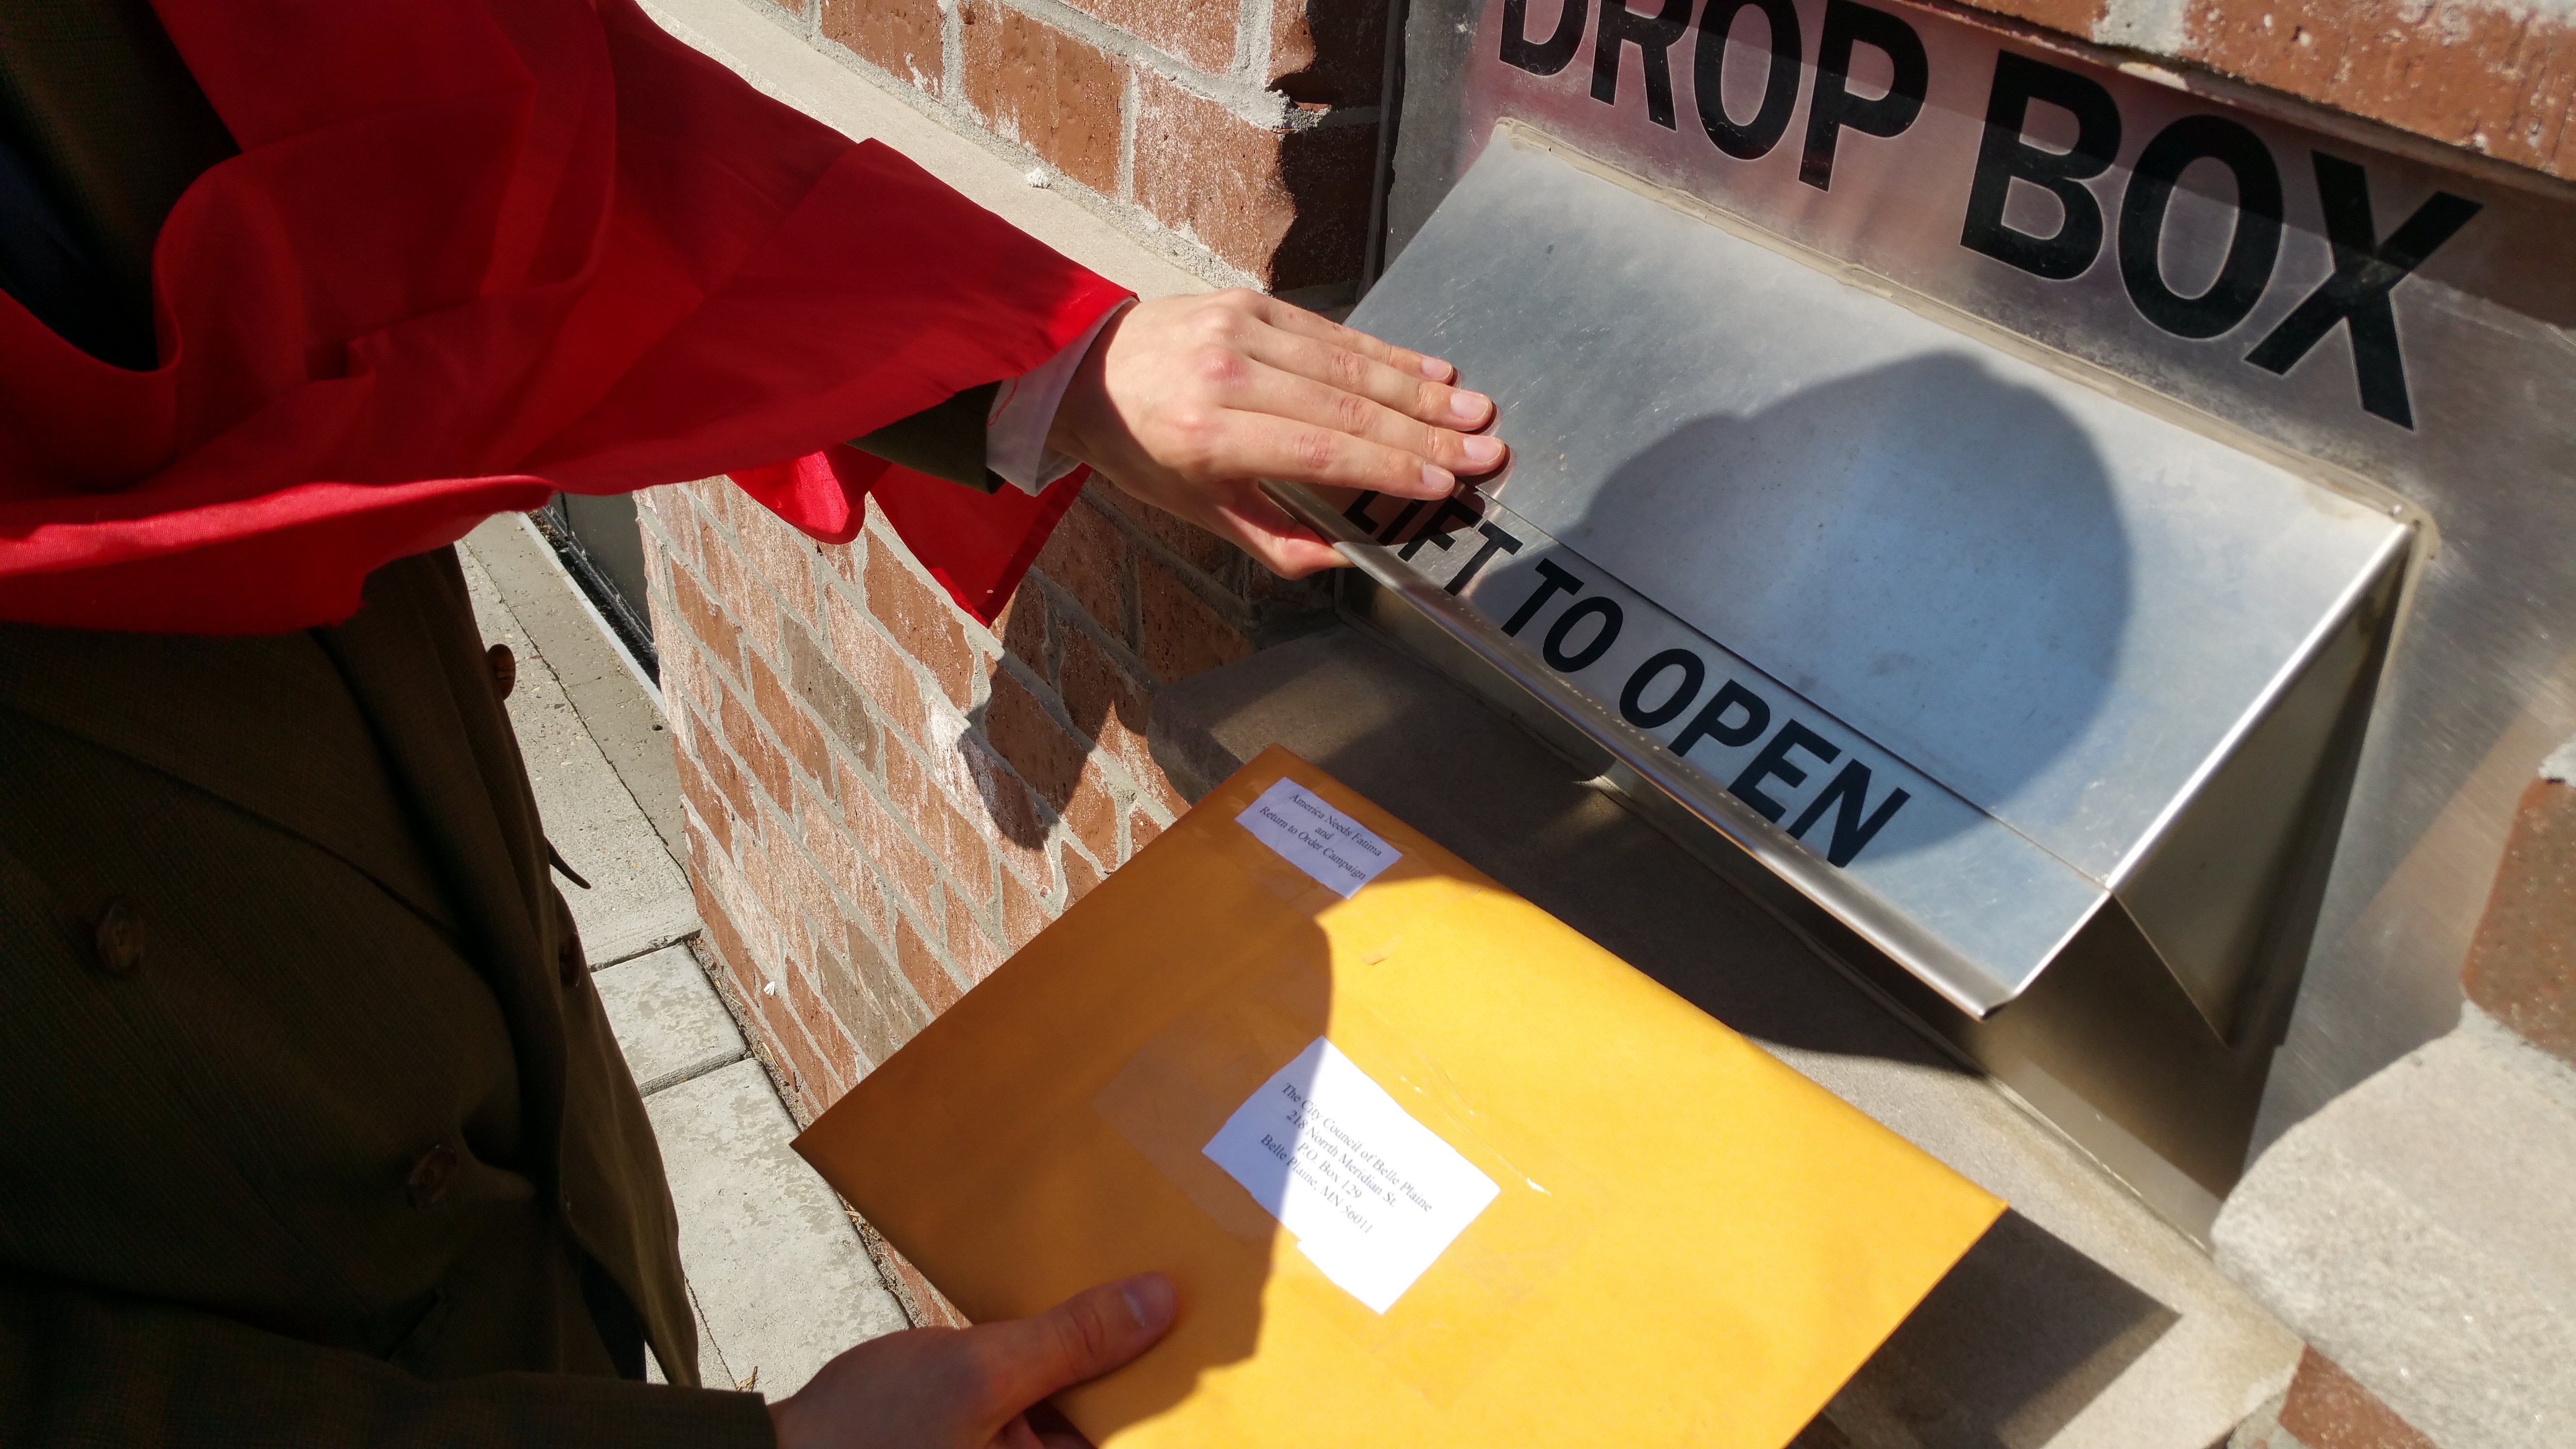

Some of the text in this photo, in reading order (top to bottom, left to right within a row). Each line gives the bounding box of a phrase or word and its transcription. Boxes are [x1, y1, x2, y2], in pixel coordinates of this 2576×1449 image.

[1960, 50, 2482, 431] BOX
[1342, 490, 1911, 868] LIFT TO OPEN
[1260, 806, 1366, 880] Return to Order Campaign
[1289, 794, 1382, 856] America Needs Fatima
[1315, 827, 1334, 839] and
[1261, 1134, 1373, 1234] Belle Plaine, MN 56011
[1282, 1082, 1432, 1212] The City Council of Belle Plaine
[1287, 1110, 1397, 1208] 218 Norrth Meridian St.
[1297, 1142, 1362, 1198] P.O. Box 129
